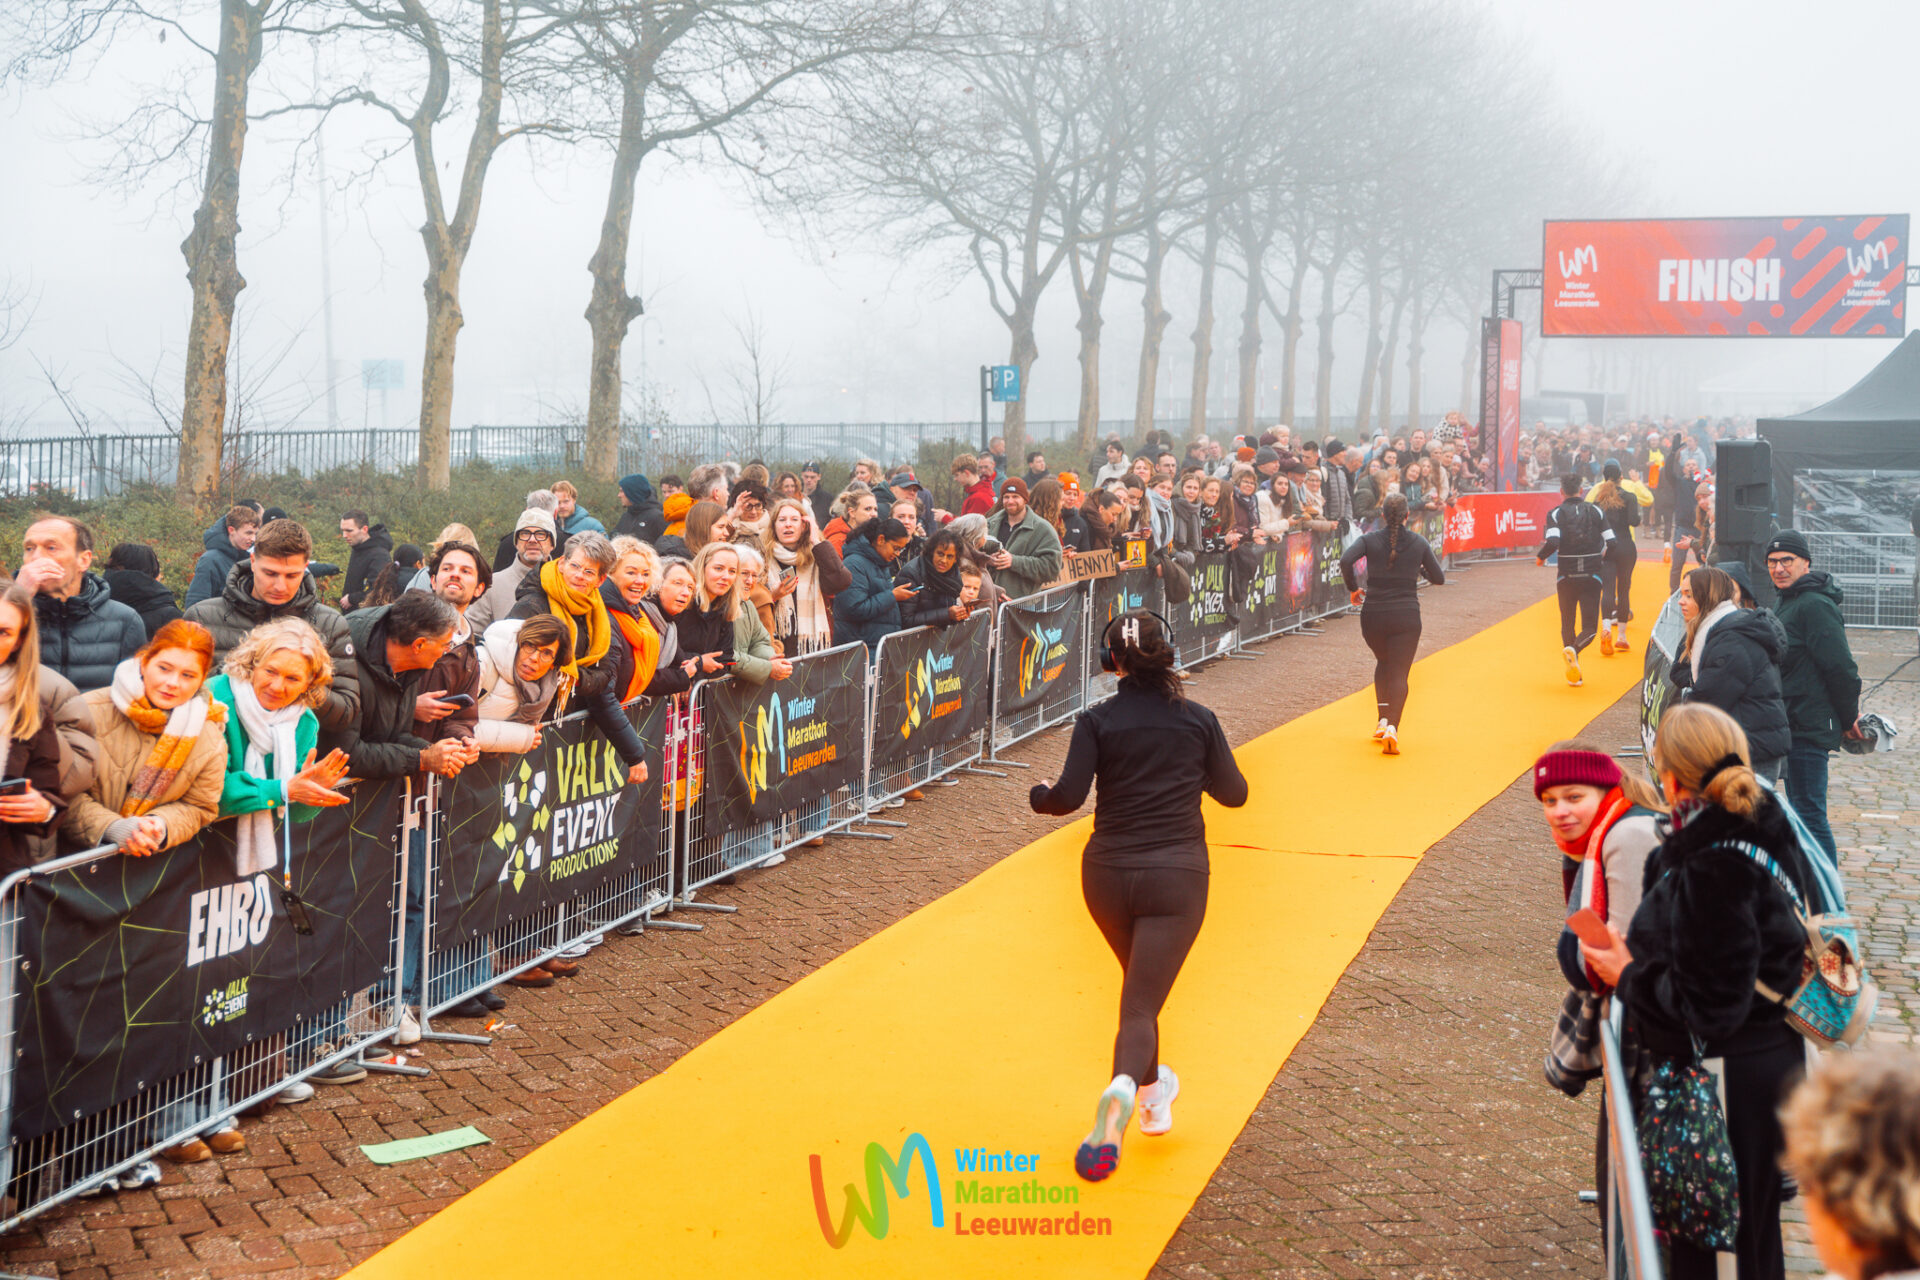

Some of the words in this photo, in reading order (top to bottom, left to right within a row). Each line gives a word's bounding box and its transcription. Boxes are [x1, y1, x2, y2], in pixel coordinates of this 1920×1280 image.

[1558, 244, 1598, 279] WM
[1847, 240, 1889, 277] WM
[1658, 257, 1781, 302] FINISH
[1846, 288, 1887, 297] Marathon
[1853, 279, 1881, 288] Winter
[1003, 369, 1015, 389] P
[1067, 552, 1115, 580] HENNY!
[787, 696, 816, 722] Winter
[787, 719, 828, 750] Marathon
[556, 739, 625, 804] VALK
[787, 741, 837, 777] Leeuwarden
[551, 791, 622, 857] EVENT
[550, 837, 620, 882] PRODUCTIONS
[187, 873, 274, 968] EHBO
